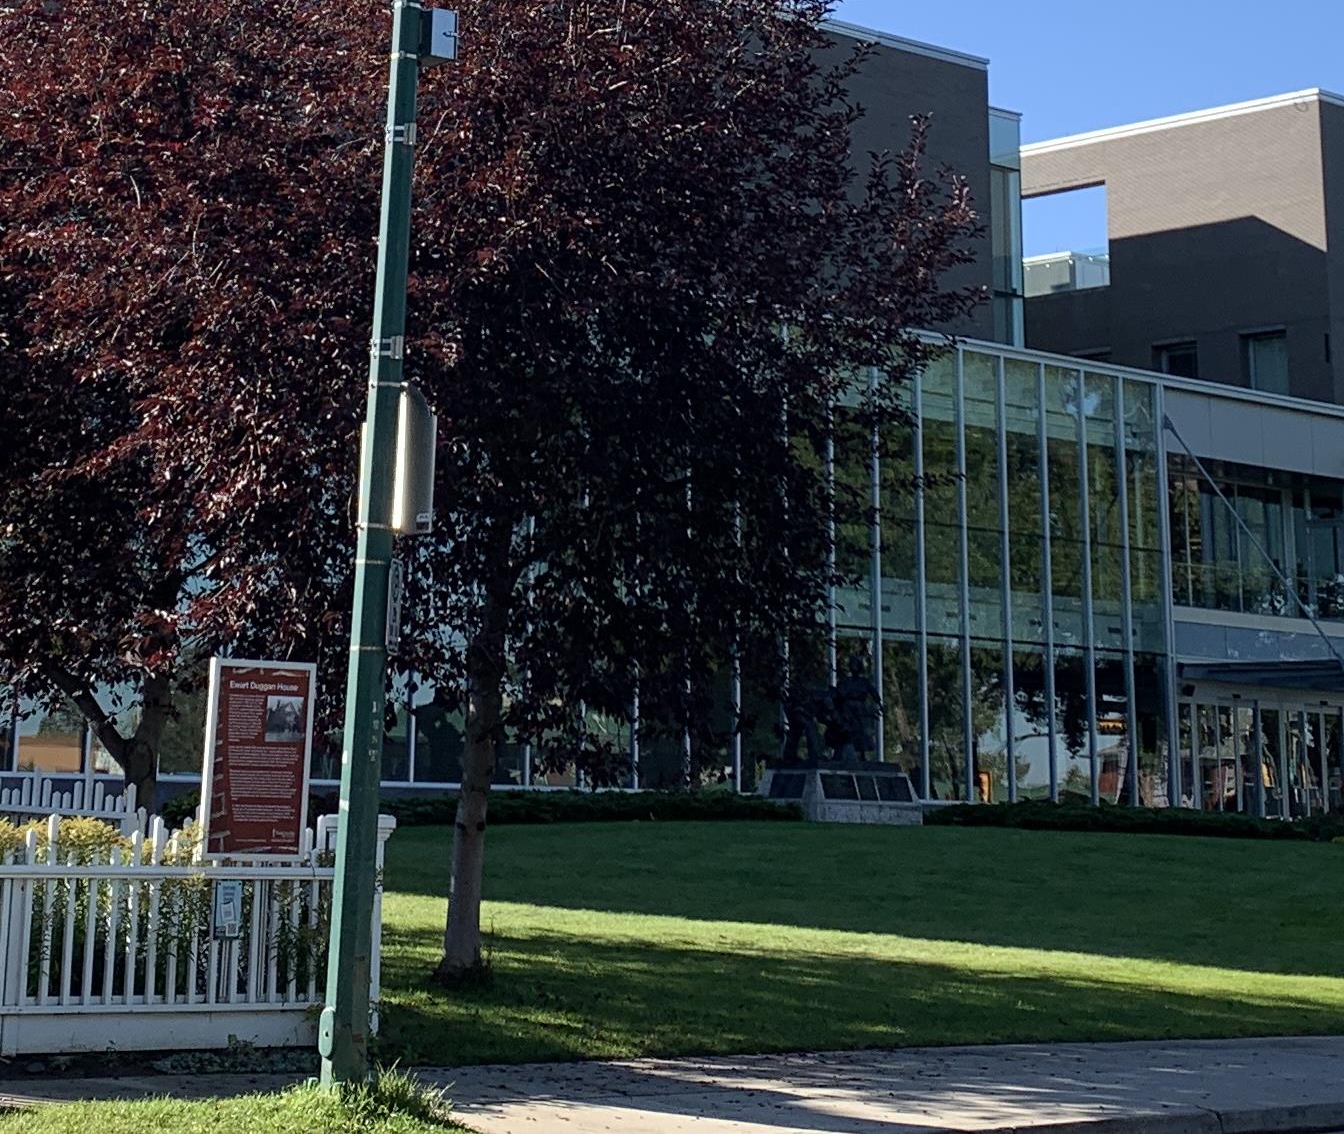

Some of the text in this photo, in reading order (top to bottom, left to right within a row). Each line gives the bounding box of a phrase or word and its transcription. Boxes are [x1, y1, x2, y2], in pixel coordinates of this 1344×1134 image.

[229, 680, 299, 692] Ewart Duggan House
